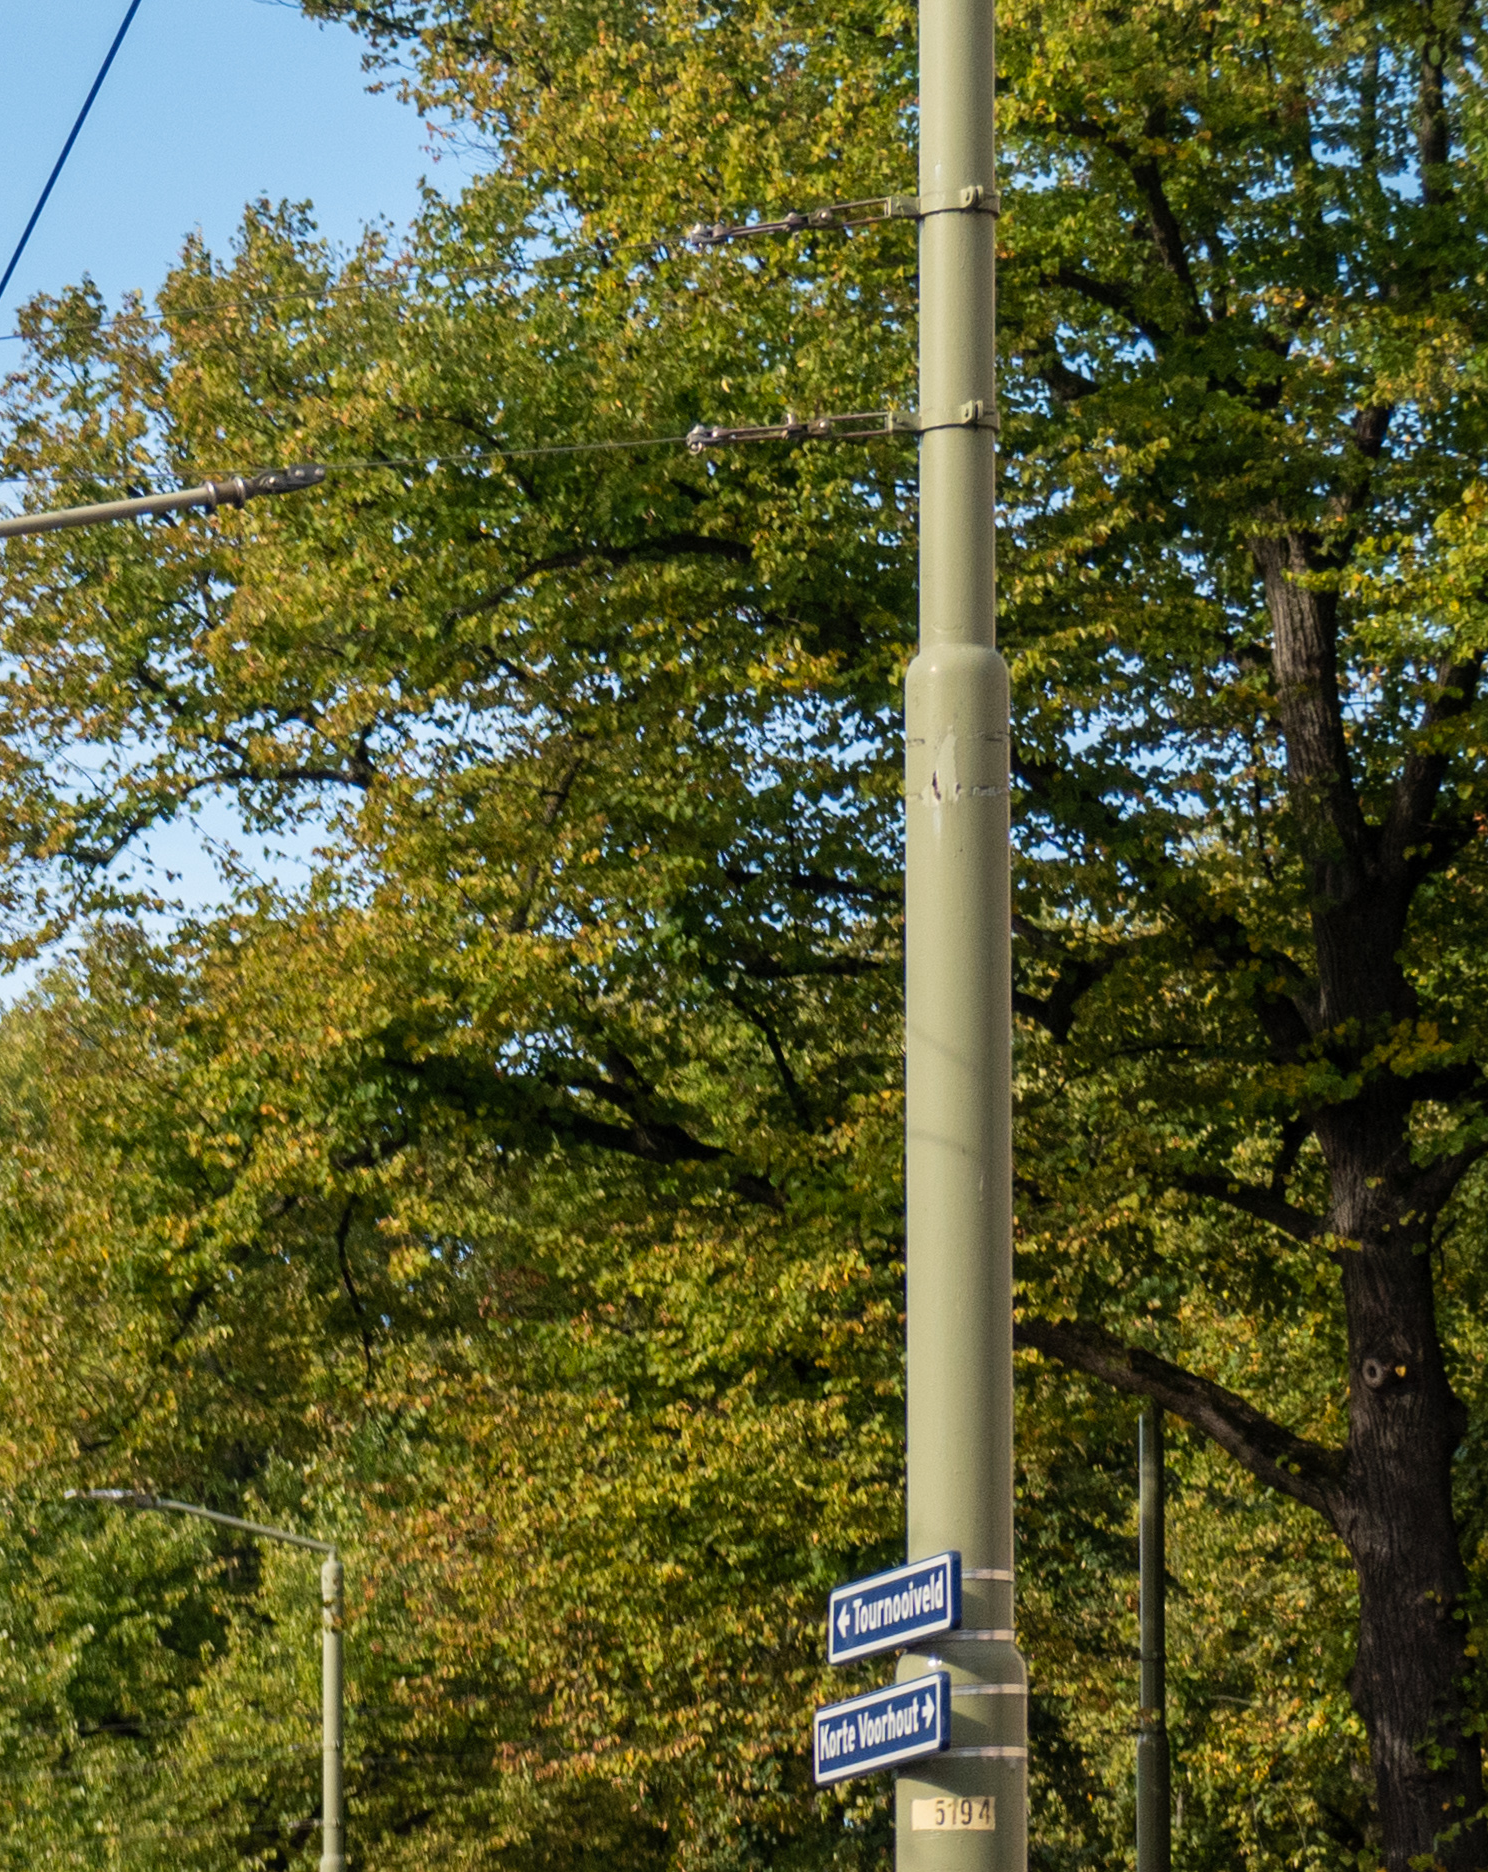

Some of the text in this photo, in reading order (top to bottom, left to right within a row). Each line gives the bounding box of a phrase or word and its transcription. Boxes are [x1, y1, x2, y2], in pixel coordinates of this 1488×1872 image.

[852, 1569, 944, 1635] Tournooiveld
[819, 1696, 920, 1762] Korte Voorhout
[935, 1799, 990, 1826] 5194
